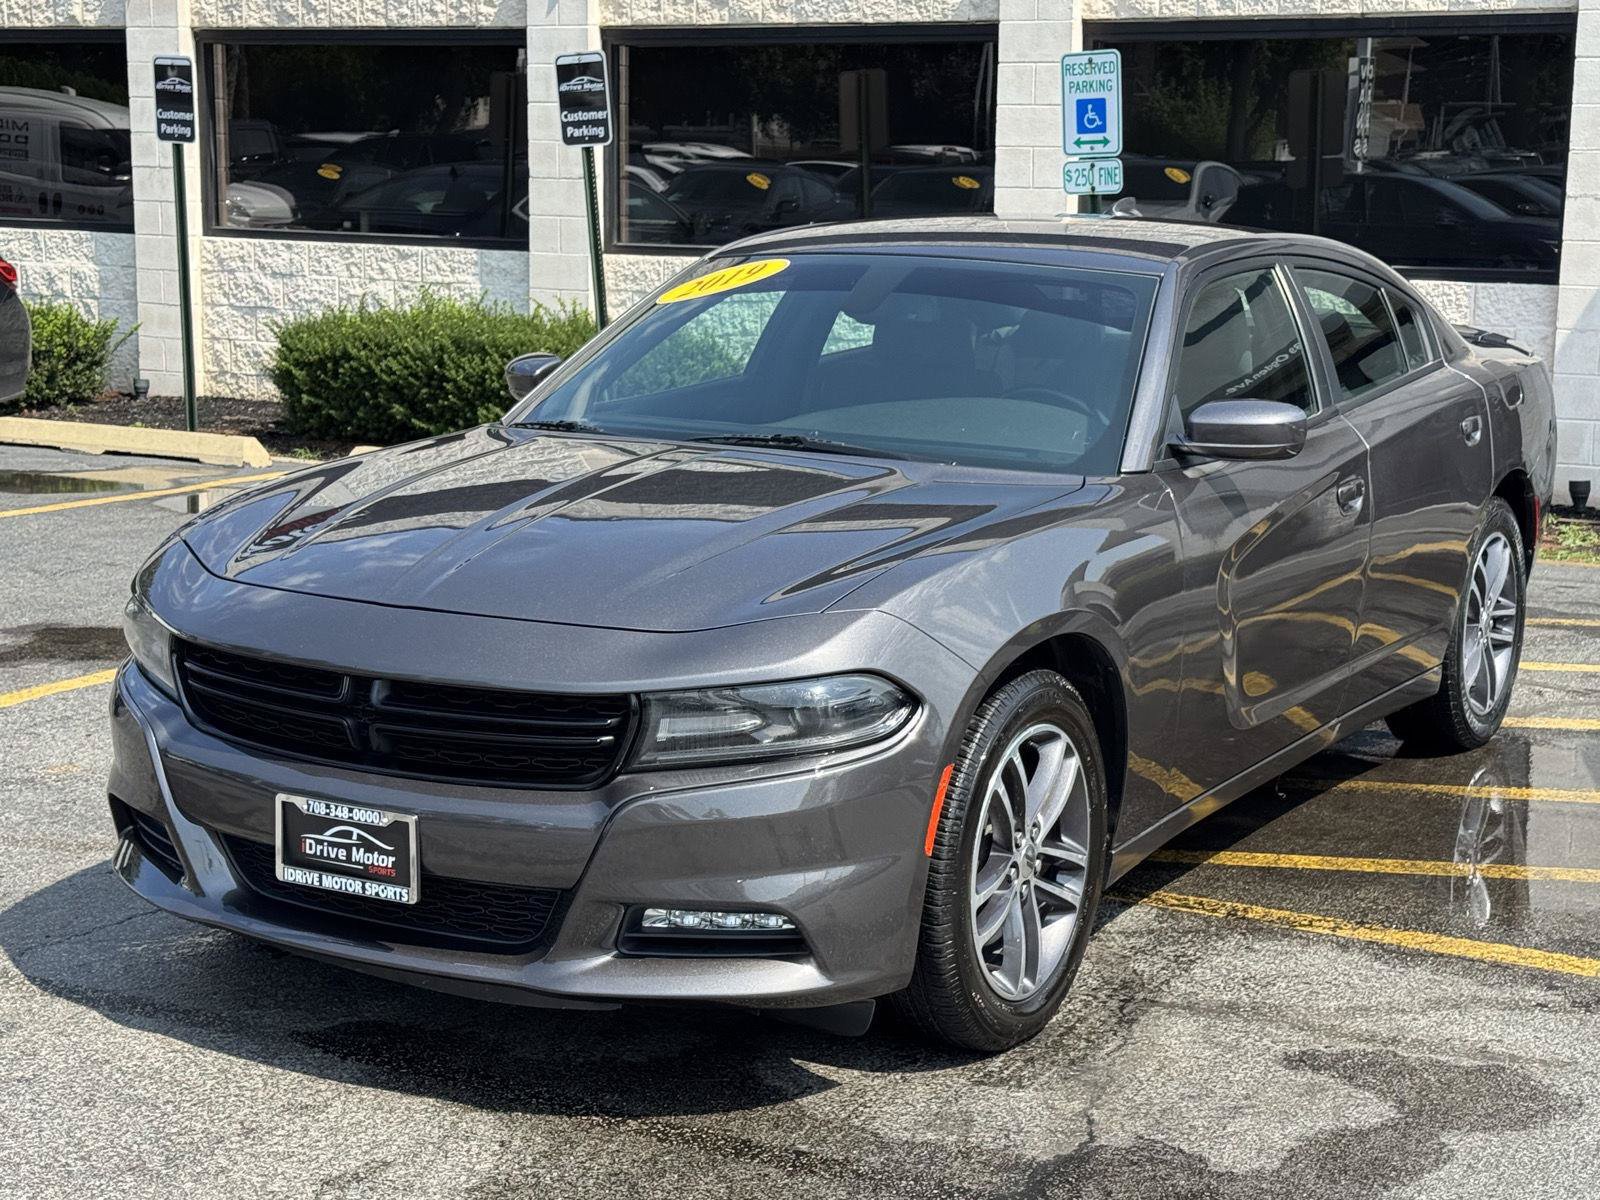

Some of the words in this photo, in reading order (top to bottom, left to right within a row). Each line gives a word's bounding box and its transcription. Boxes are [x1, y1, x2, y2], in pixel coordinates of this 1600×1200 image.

[1065, 61, 1115, 77] RESERVED
[1069, 79, 1113, 94] PARKING
[157, 108, 194, 121] Customer
[561, 110, 608, 122] Customer
[161, 123, 191, 137] Parking
[566, 124, 605, 138] Parking
[1098, 166, 1120, 186] FINE
[675, 263, 768, 298] 2019
[308, 801, 381, 824] 708-348-0000
[301, 839, 346, 860] iDrive
[351, 846, 396, 867] Motor
[368, 865, 396, 877] SPORTS
[321, 874, 362, 894] MOTOR
[364, 882, 409, 902] SPORTS
